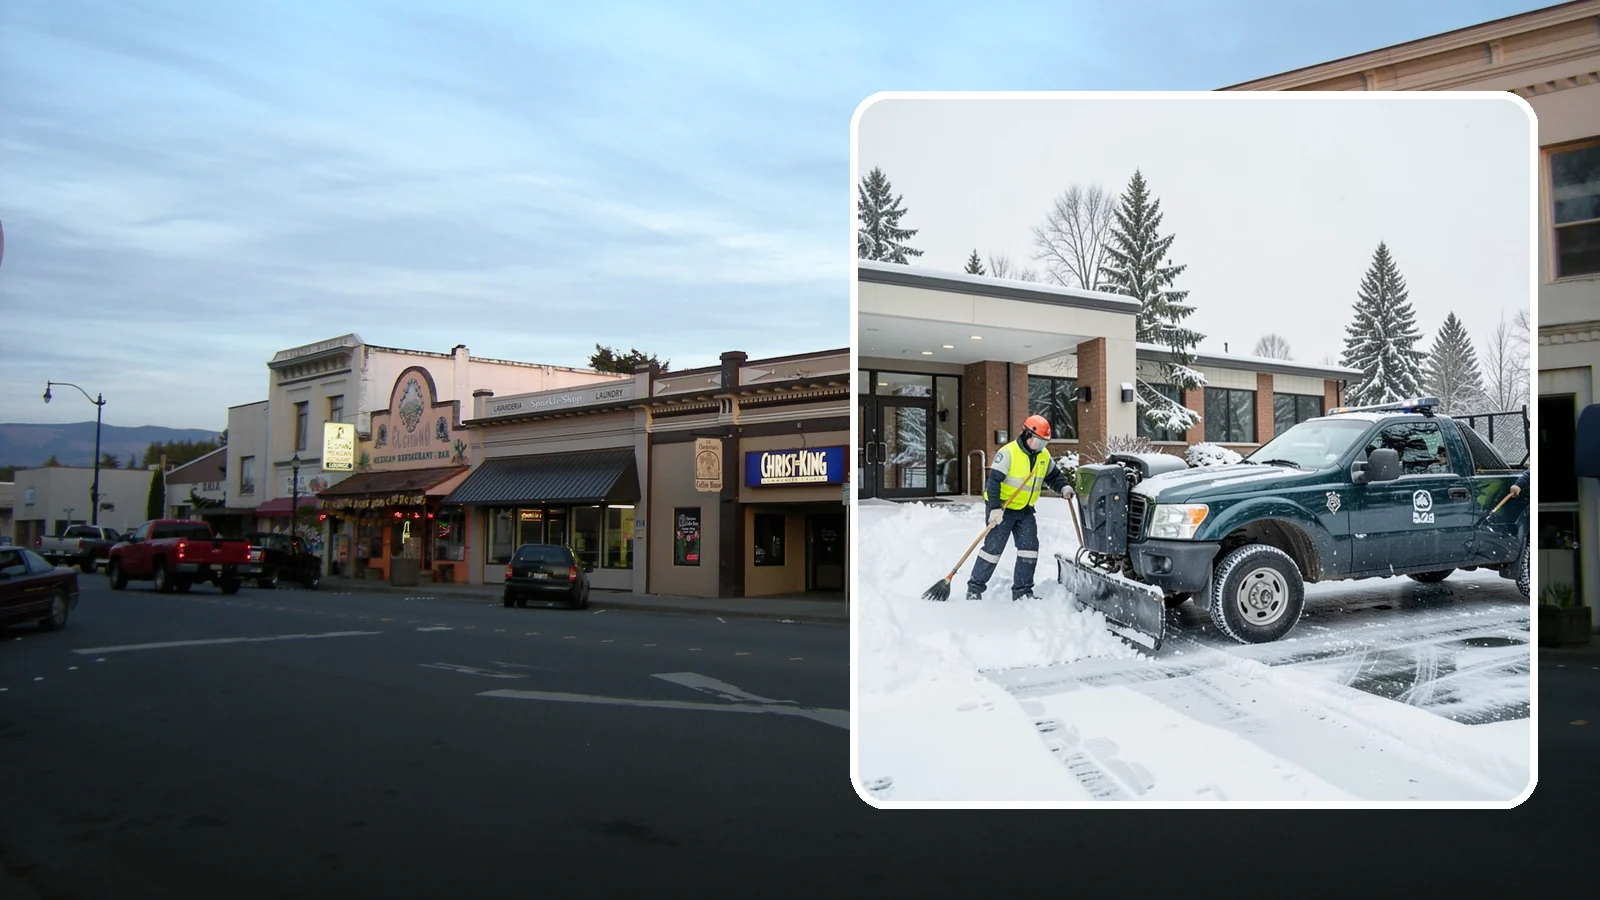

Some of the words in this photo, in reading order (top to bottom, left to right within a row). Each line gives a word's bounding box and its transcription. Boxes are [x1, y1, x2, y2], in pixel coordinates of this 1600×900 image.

[595, 389, 624, 399] LAUNDRY
[493, 402, 523, 412] LAVANDERIA
[530, 397, 560, 409] Sparkle
[562, 394, 582, 404] Shop
[392, 426, 402, 449] EL
[373, 455, 396, 464] MEXICAN
[397, 451, 433, 462] RESTAURANT
[438, 450, 450, 458] BAR
[761, 452, 797, 478] CHRIST
[799, 449, 827, 476] KING
